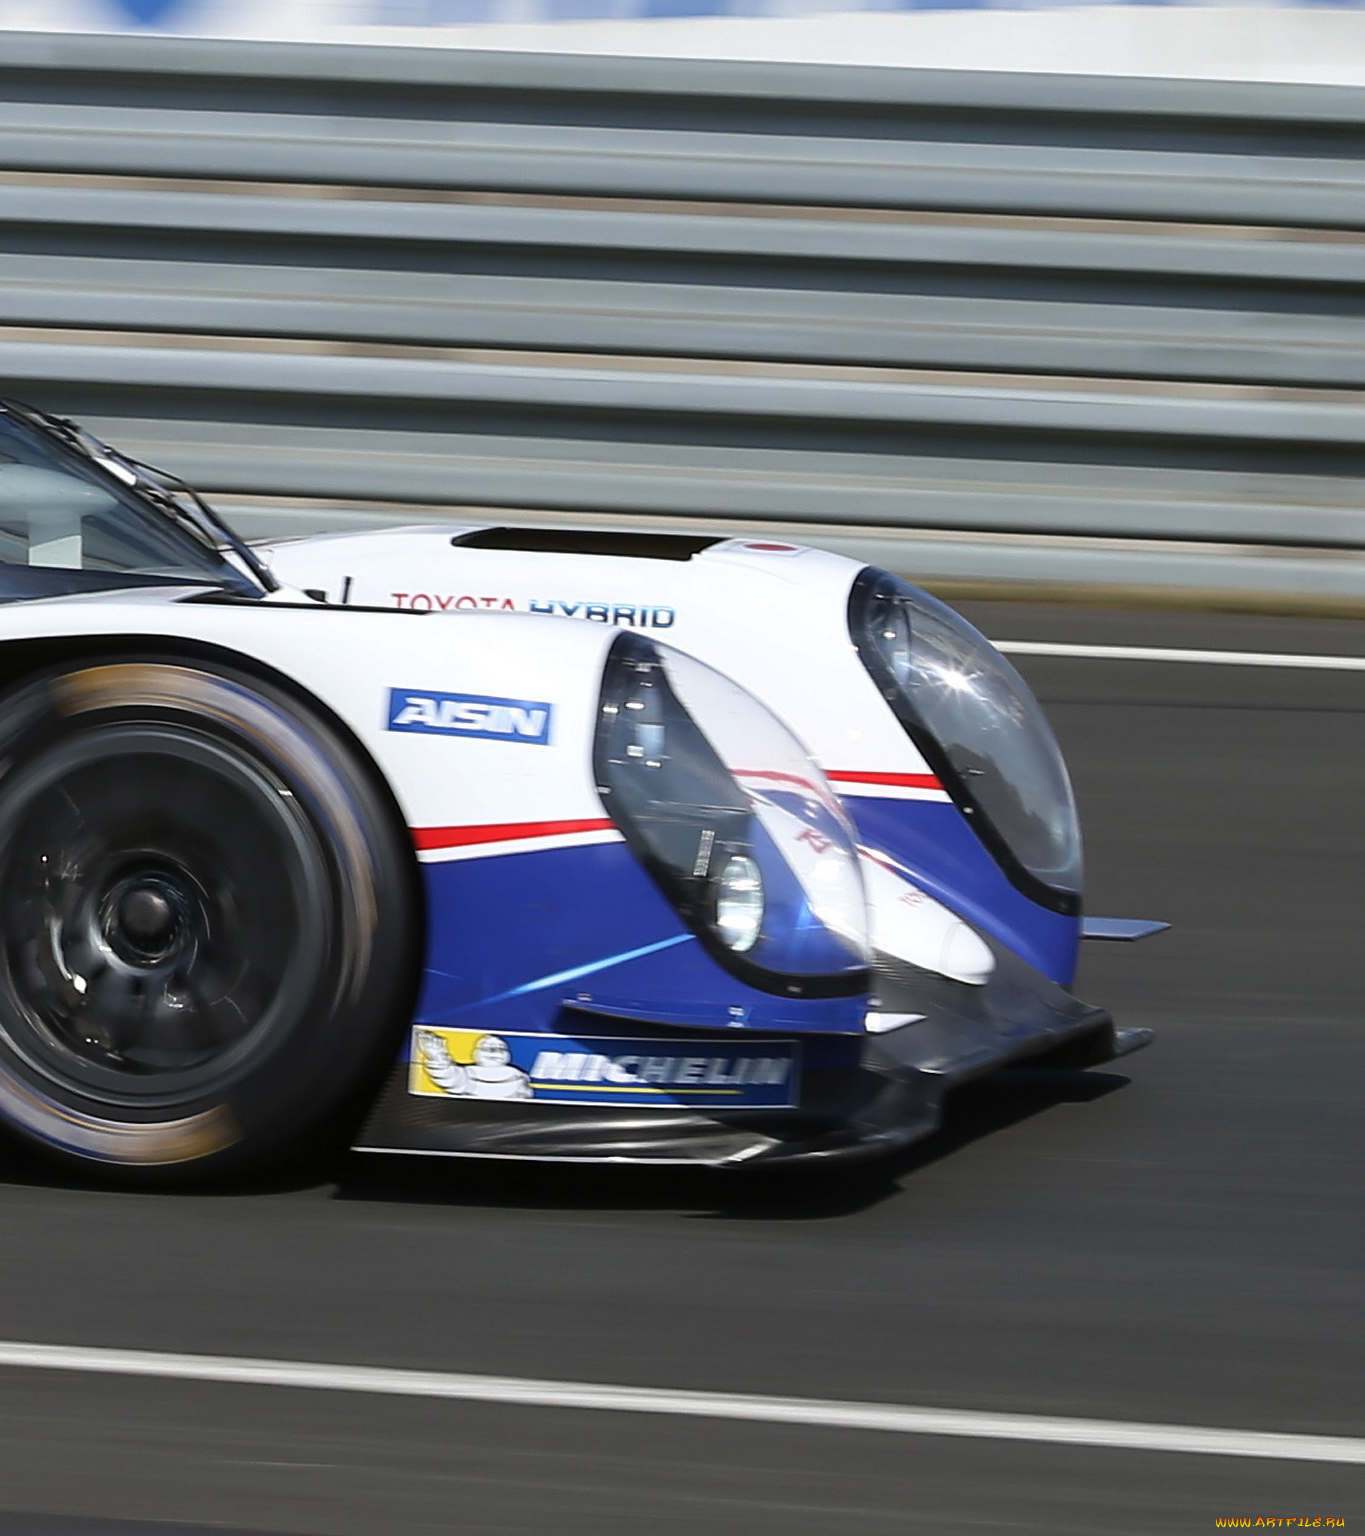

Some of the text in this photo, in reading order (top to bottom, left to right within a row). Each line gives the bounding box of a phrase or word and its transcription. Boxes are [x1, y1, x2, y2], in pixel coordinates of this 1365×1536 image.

[529, 599, 676, 628] HYBRID
[393, 697, 547, 737] AISIN
[529, 1051, 793, 1085] MICHELIN
